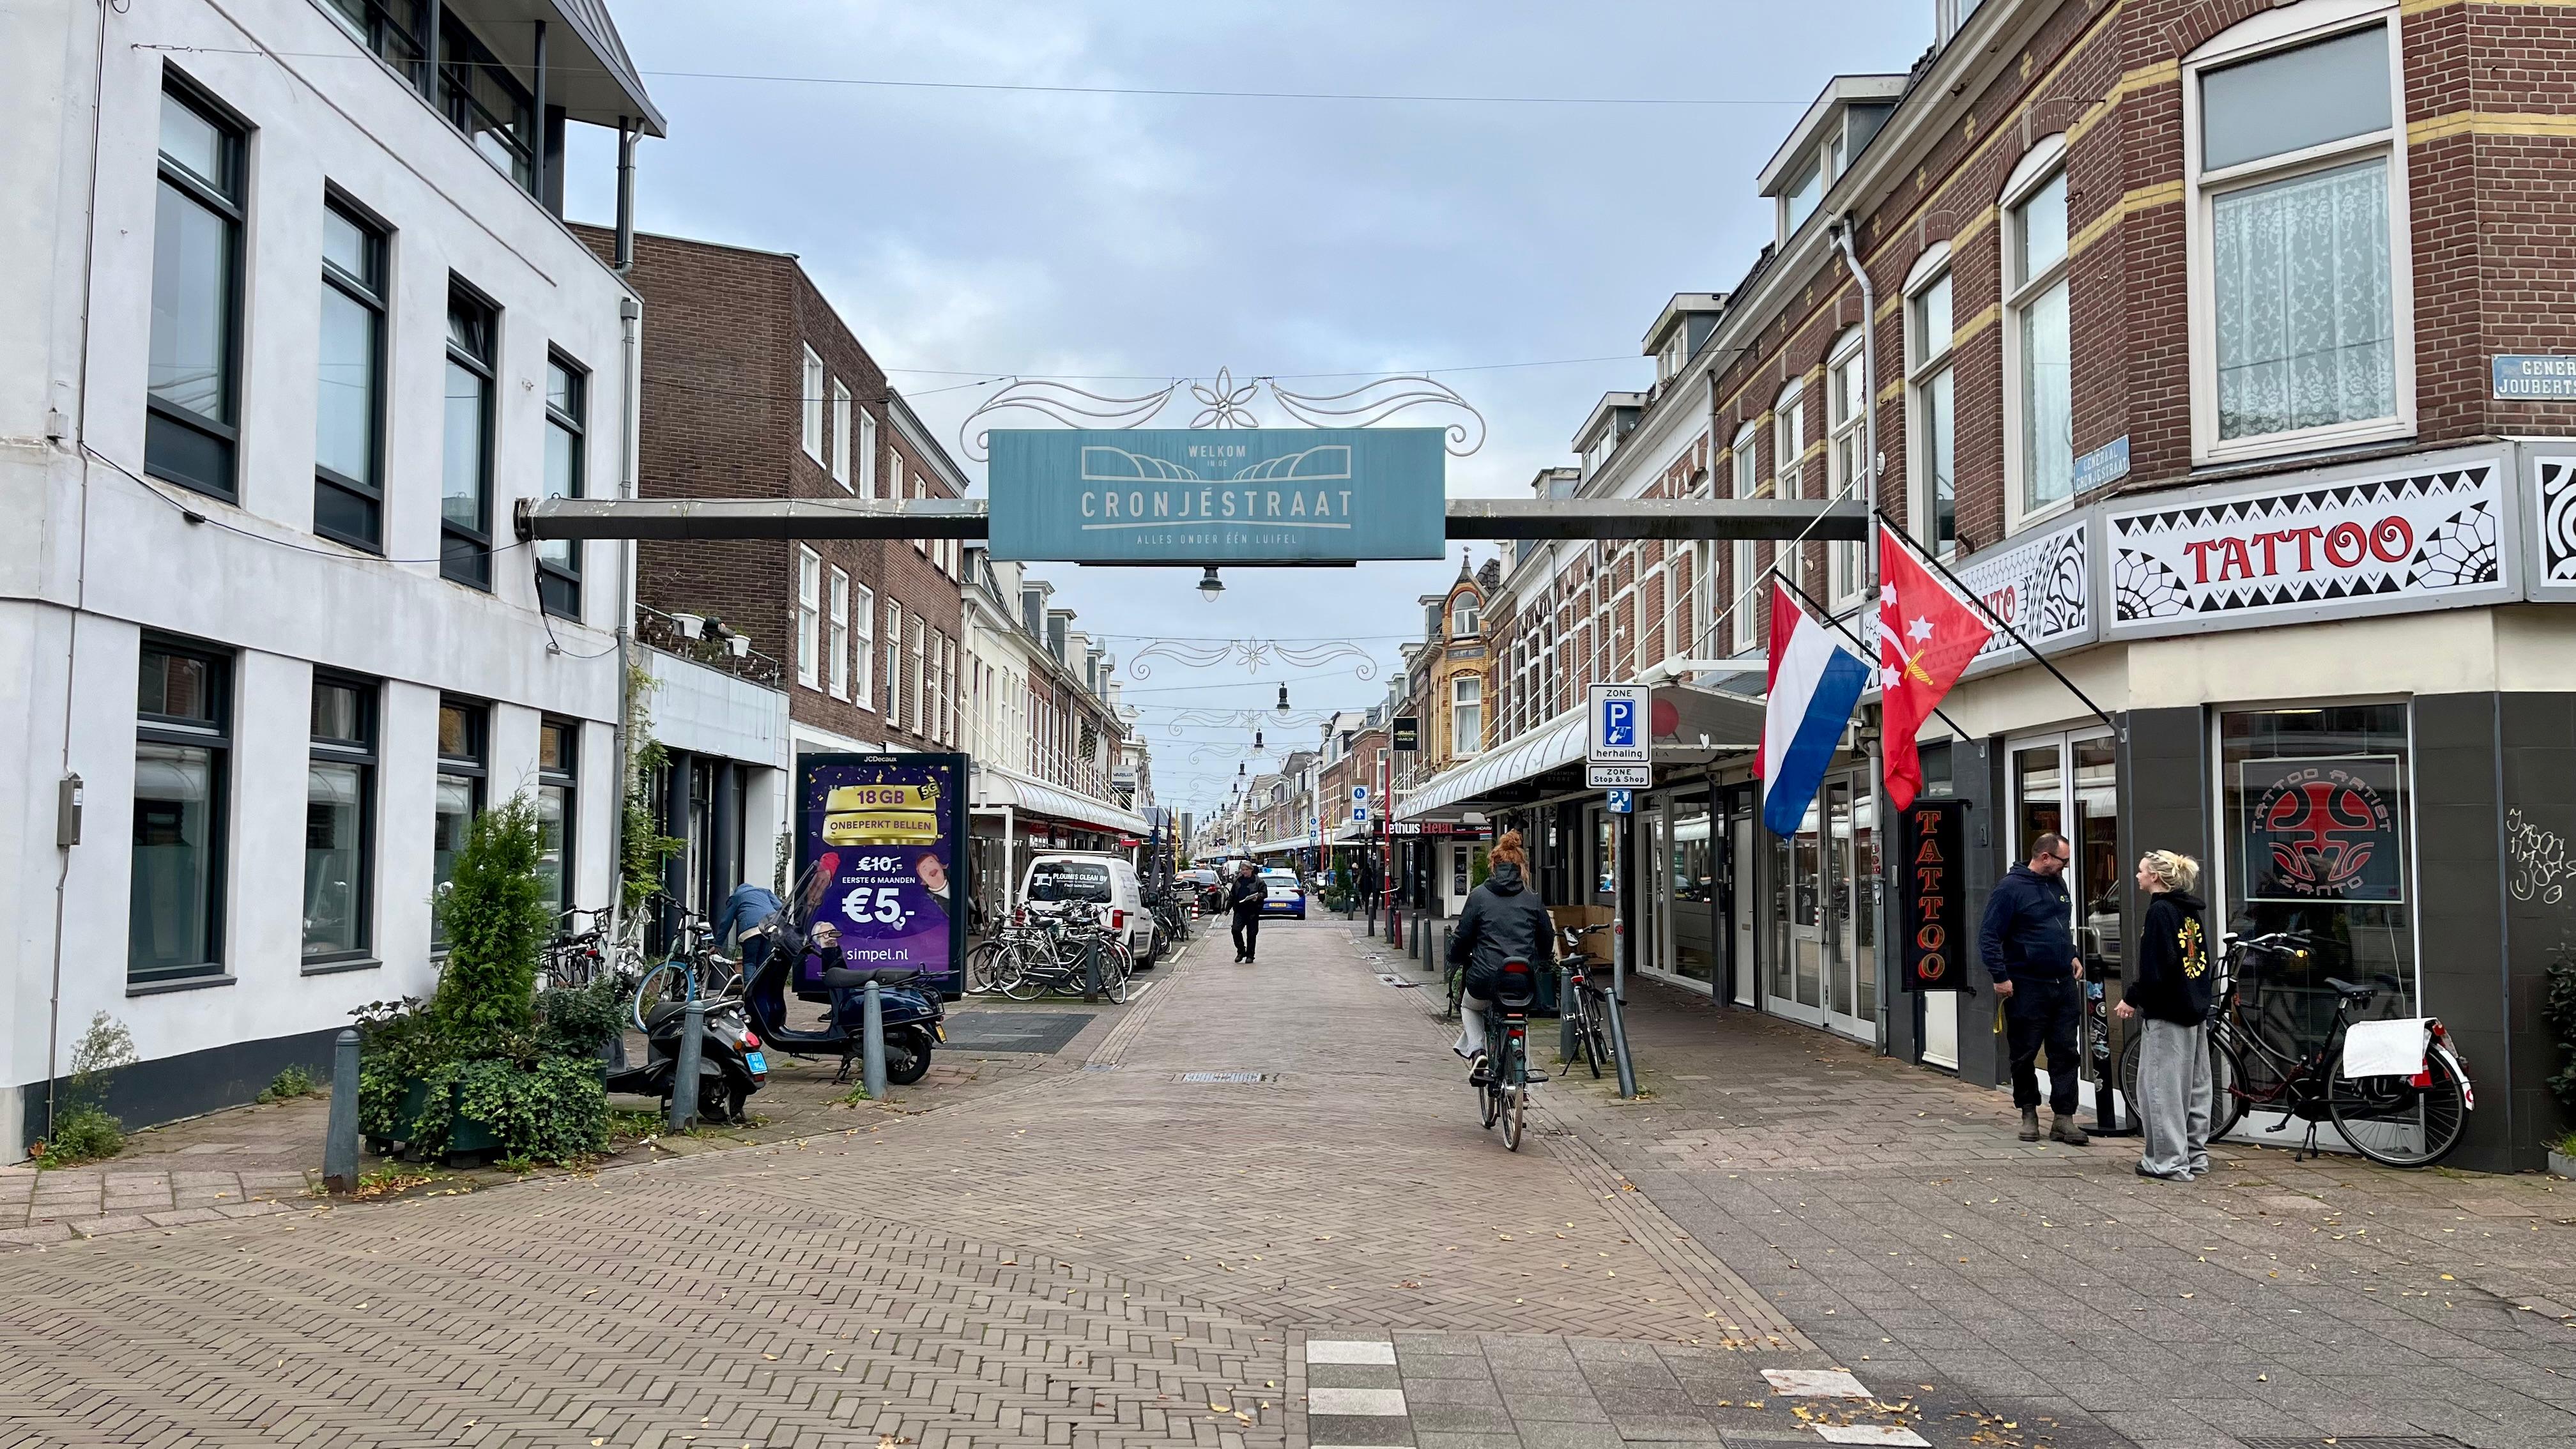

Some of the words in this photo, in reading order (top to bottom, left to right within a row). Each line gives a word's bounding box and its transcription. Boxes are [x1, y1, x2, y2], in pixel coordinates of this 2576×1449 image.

[2522, 361, 2576, 376] GENER
[2498, 379, 2576, 394] JOUBERT
[1188, 445, 1246, 457] WELKOM
[2083, 446, 2118, 471] GENERAAL
[1081, 487, 1352, 518] CRONJÉSTRAAT
[1137, 535, 1172, 545] ALLES
[1180, 535, 1218, 545] ONDER
[1226, 532, 1248, 544] ÉÉN
[1255, 534, 1298, 544] LUIFEL
[2184, 515, 2414, 584] TATTOO
[1611, 704, 1628, 727] P
[1597, 749, 1643, 760] herhaling
[921, 783, 939, 795] 5G
[857, 790, 876, 804] 18
[879, 790, 904, 804] GB
[2252, 769, 2319, 833] TATTOO
[2329, 769, 2392, 833] ARTIST
[831, 820, 891, 831] ONBEPERKT
[894, 820, 931, 831] BELLEN
[2280, 875, 2363, 896] ZANTO
[1916, 811, 1945, 980] TATTOO
[841, 887, 915, 927] €5,-
[847, 948, 908, 963] simpel.nl
